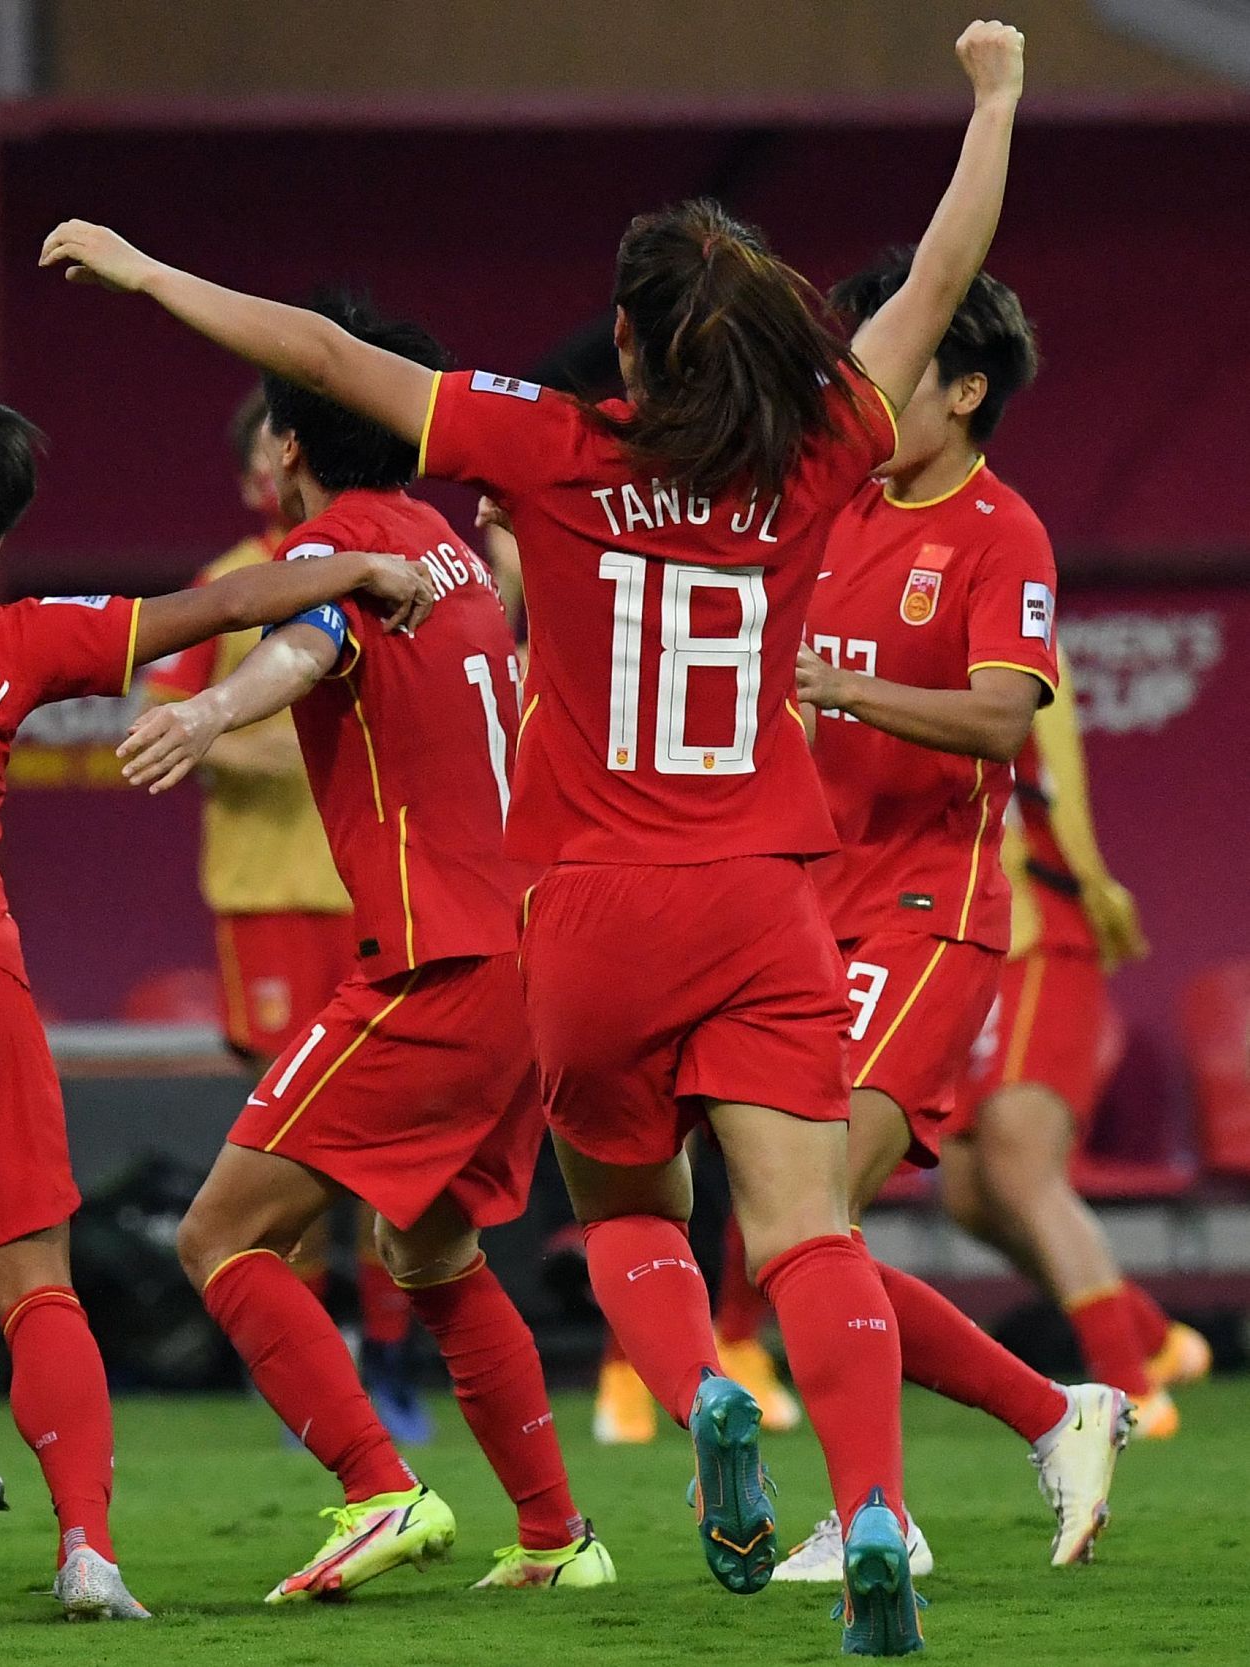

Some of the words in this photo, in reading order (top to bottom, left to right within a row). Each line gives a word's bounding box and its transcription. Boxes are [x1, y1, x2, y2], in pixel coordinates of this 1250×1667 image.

[591, 478, 710, 536] TANG
[1026, 599, 1044, 608] OUR
[598, 551, 768, 775] 18
[272, 1023, 327, 1099] 1
[627, 1258, 701, 1282] CFA
[848, 1318, 887, 1331] 中国
